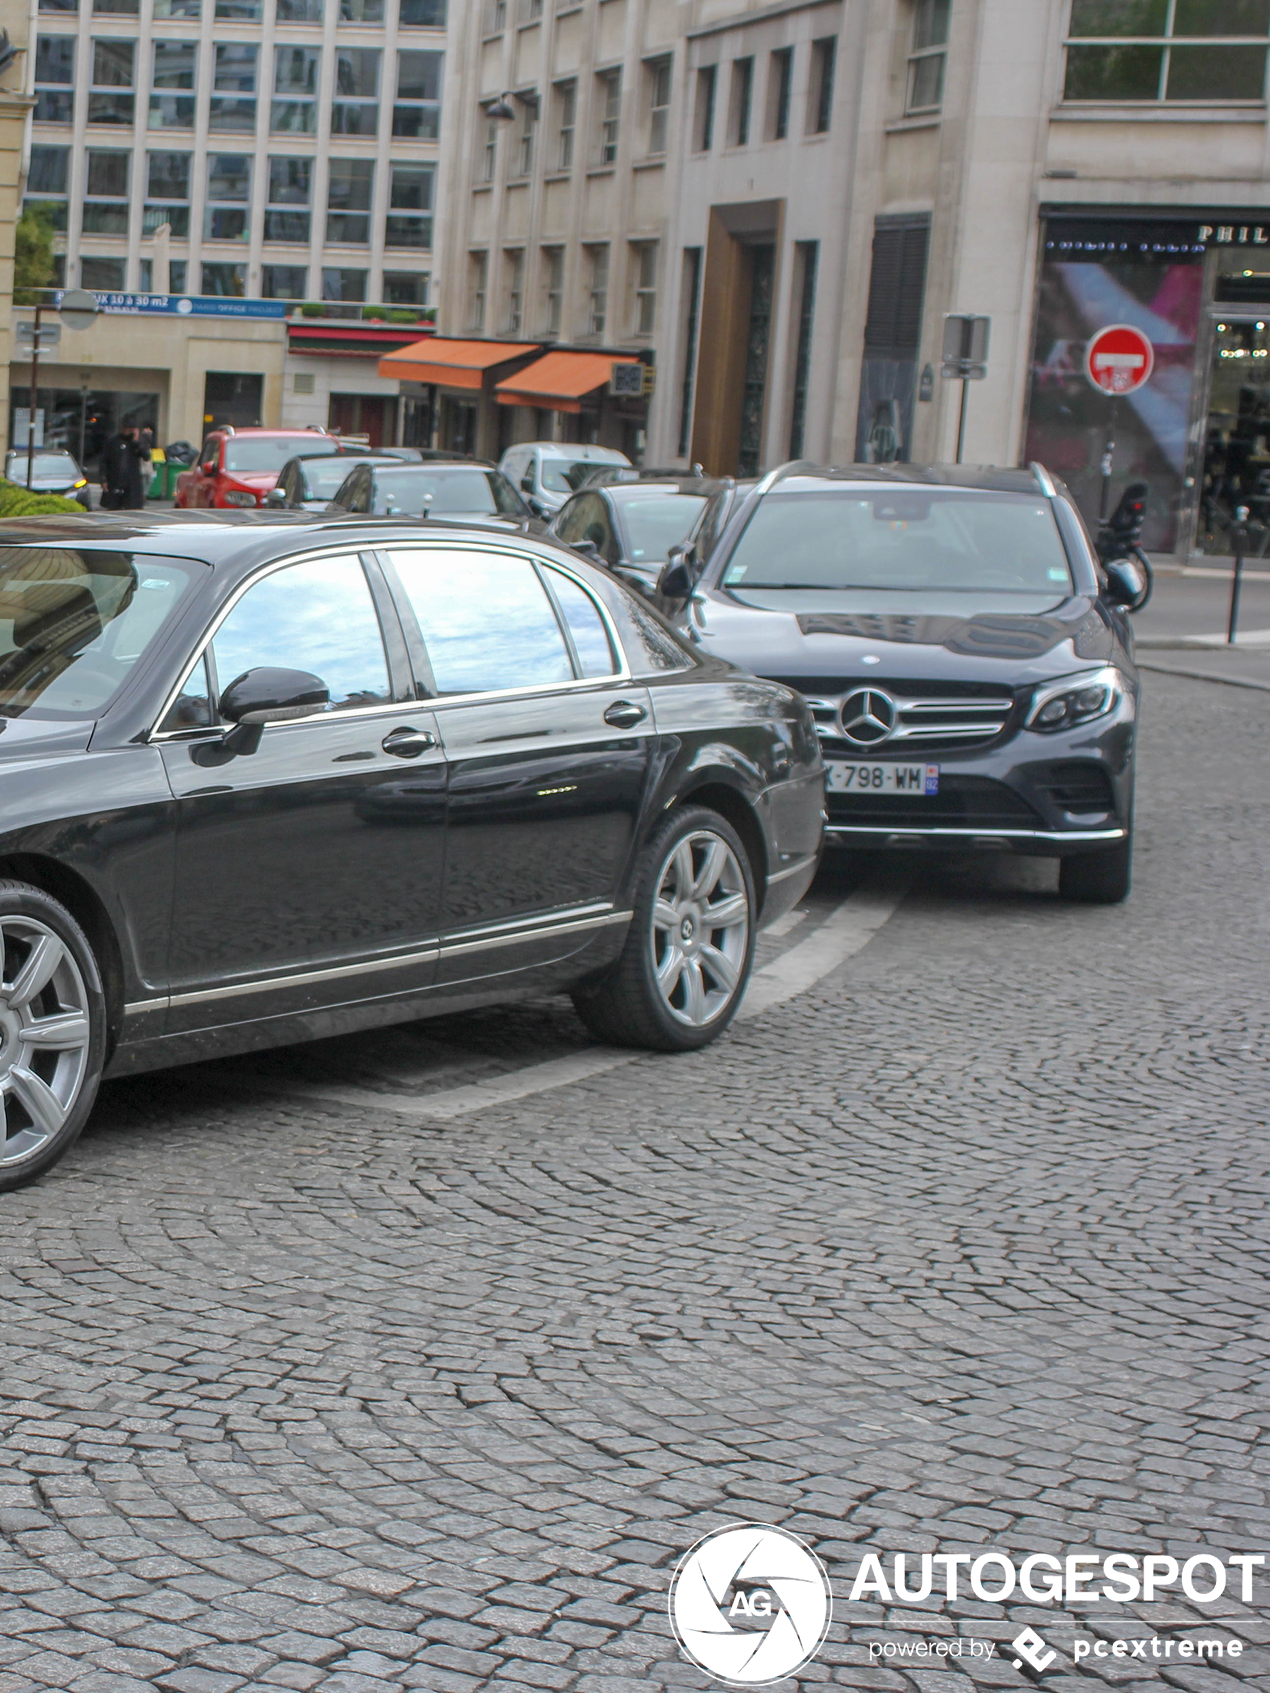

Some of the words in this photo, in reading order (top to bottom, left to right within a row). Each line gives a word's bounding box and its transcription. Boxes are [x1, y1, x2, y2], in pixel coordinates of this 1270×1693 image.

[111, 294, 124, 305] 10
[136, 297, 149, 307] 30
[152, 296, 169, 307] m2
